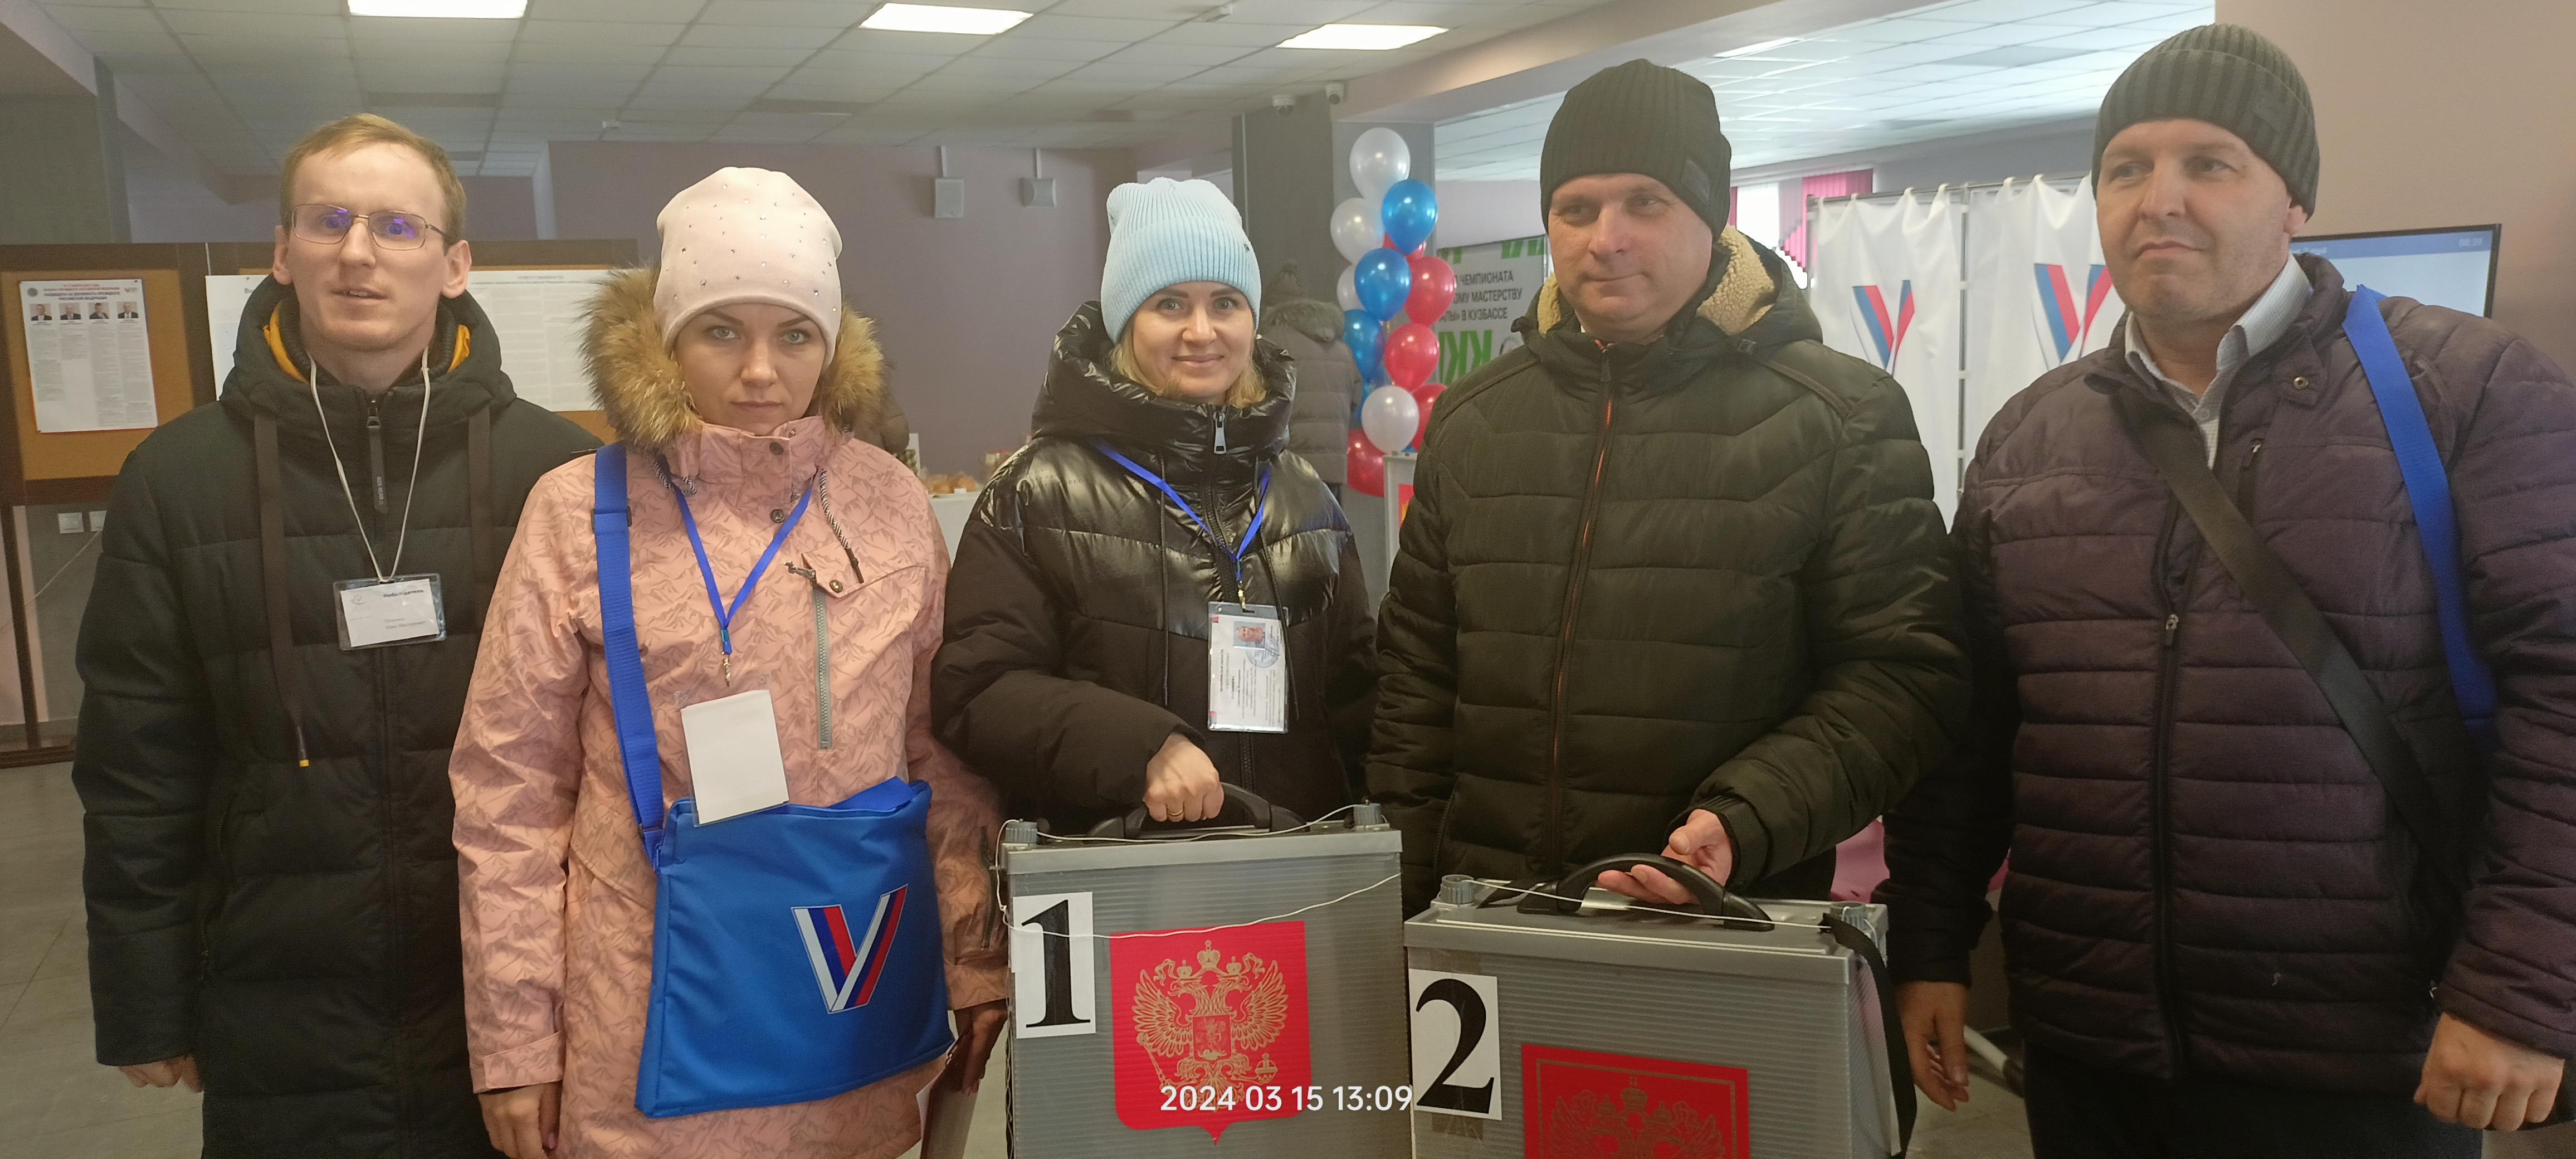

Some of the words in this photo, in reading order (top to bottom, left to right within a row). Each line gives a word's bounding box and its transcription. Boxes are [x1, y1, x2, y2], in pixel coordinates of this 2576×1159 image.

[1460, 270, 1514, 285] ЧЕМПИОНАТА
[1471, 288, 1523, 302] МАСТЕРСТВУ
[1462, 309, 1466, 320] В
[1468, 307, 1507, 321] КУЗБАССЕ
[1021, 899, 1091, 1028] 1
[1416, 978, 1495, 1114] 2
